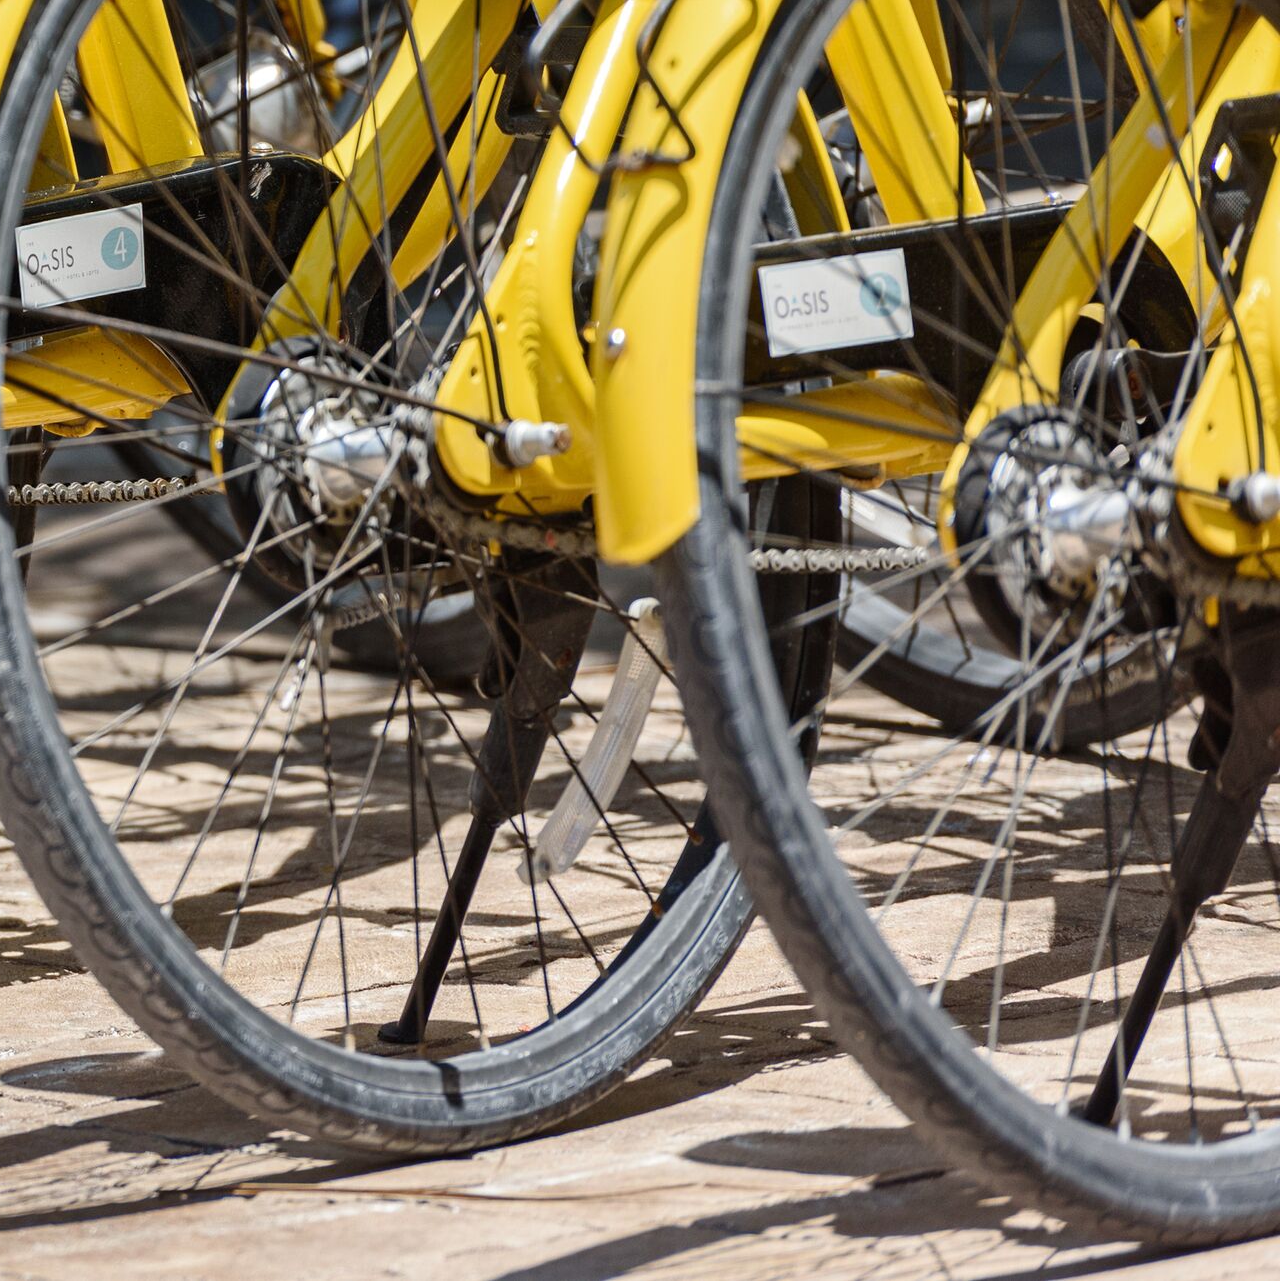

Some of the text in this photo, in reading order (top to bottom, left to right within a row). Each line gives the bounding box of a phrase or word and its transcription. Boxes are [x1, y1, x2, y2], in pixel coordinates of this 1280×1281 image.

[26, 230, 128, 276] OASIS 4
[773, 289, 831, 320] OASIS
